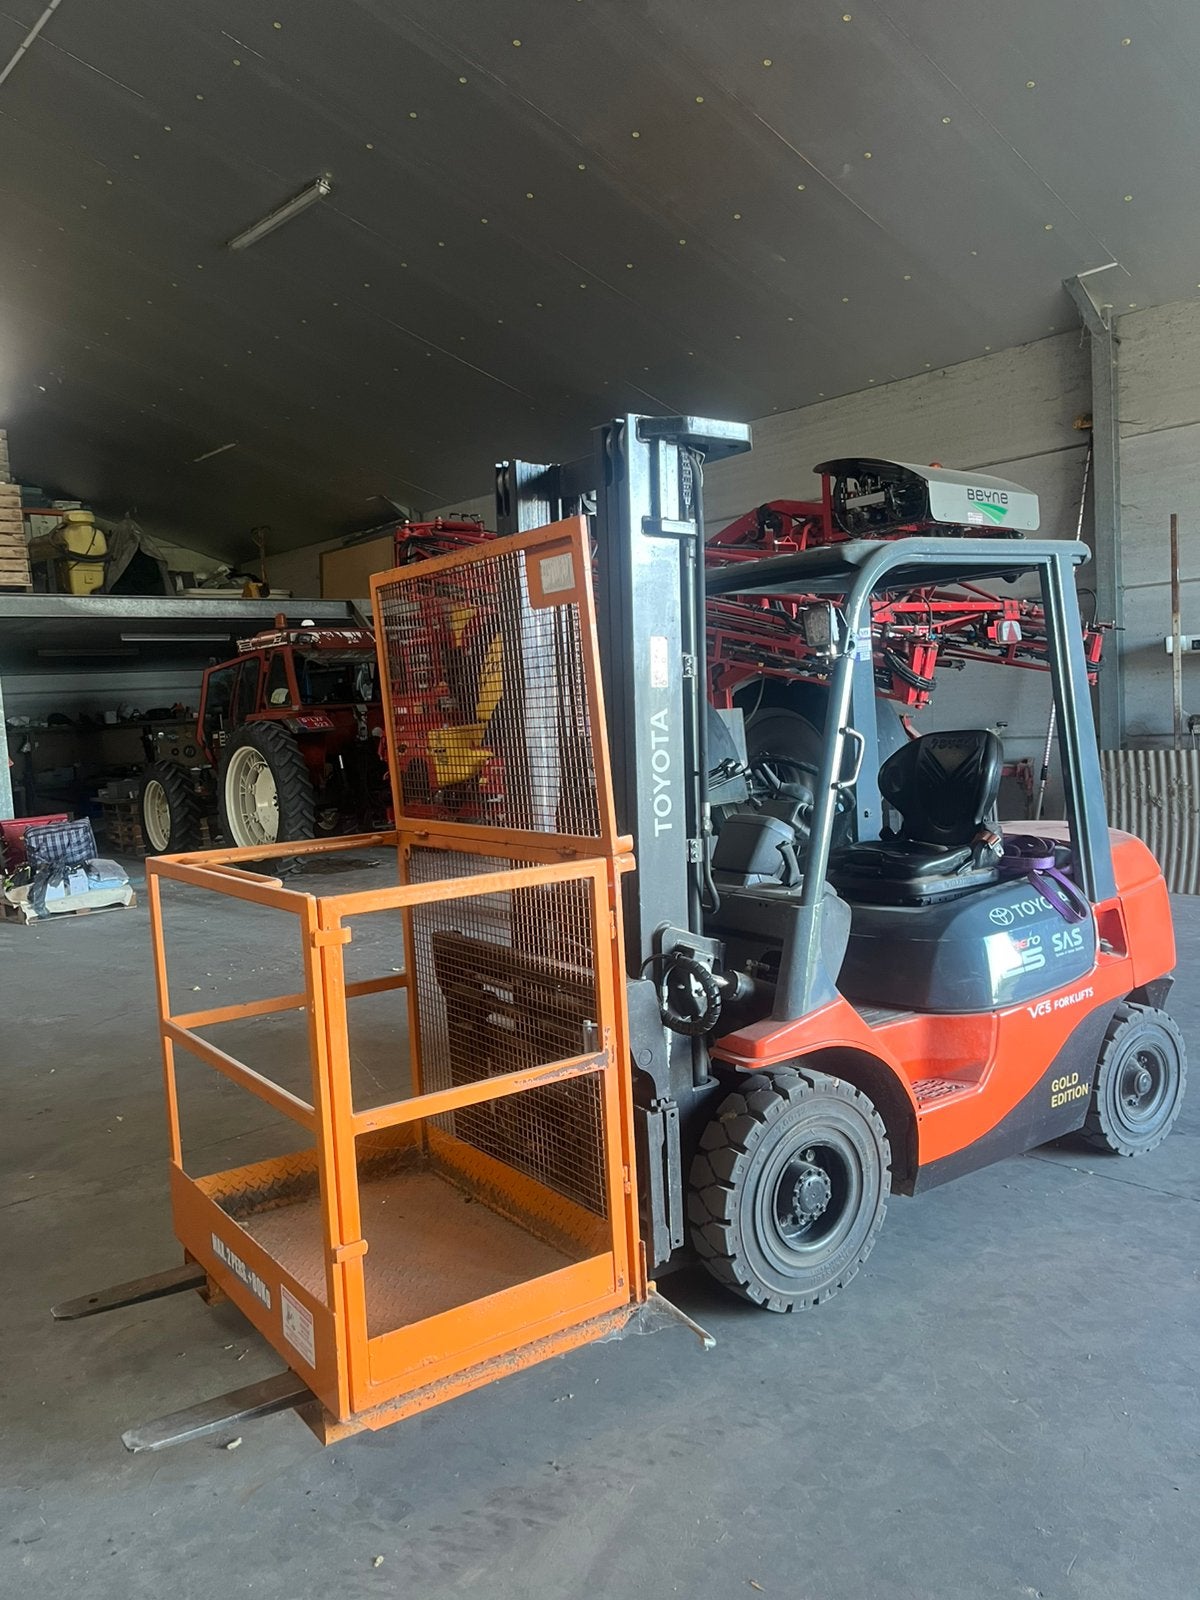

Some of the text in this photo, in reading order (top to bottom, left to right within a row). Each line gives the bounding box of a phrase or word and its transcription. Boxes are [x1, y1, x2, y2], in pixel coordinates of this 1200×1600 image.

[651, 708, 673, 837] TOYOTA
[1011, 890, 1069, 918] TOYOA
[1052, 927, 1083, 952] SAS
[1027, 986, 1094, 1019] VCS FORKLIFTS
[1051, 1072, 1079, 1092] GOLD
[1051, 1083, 1089, 1108] EDITION
